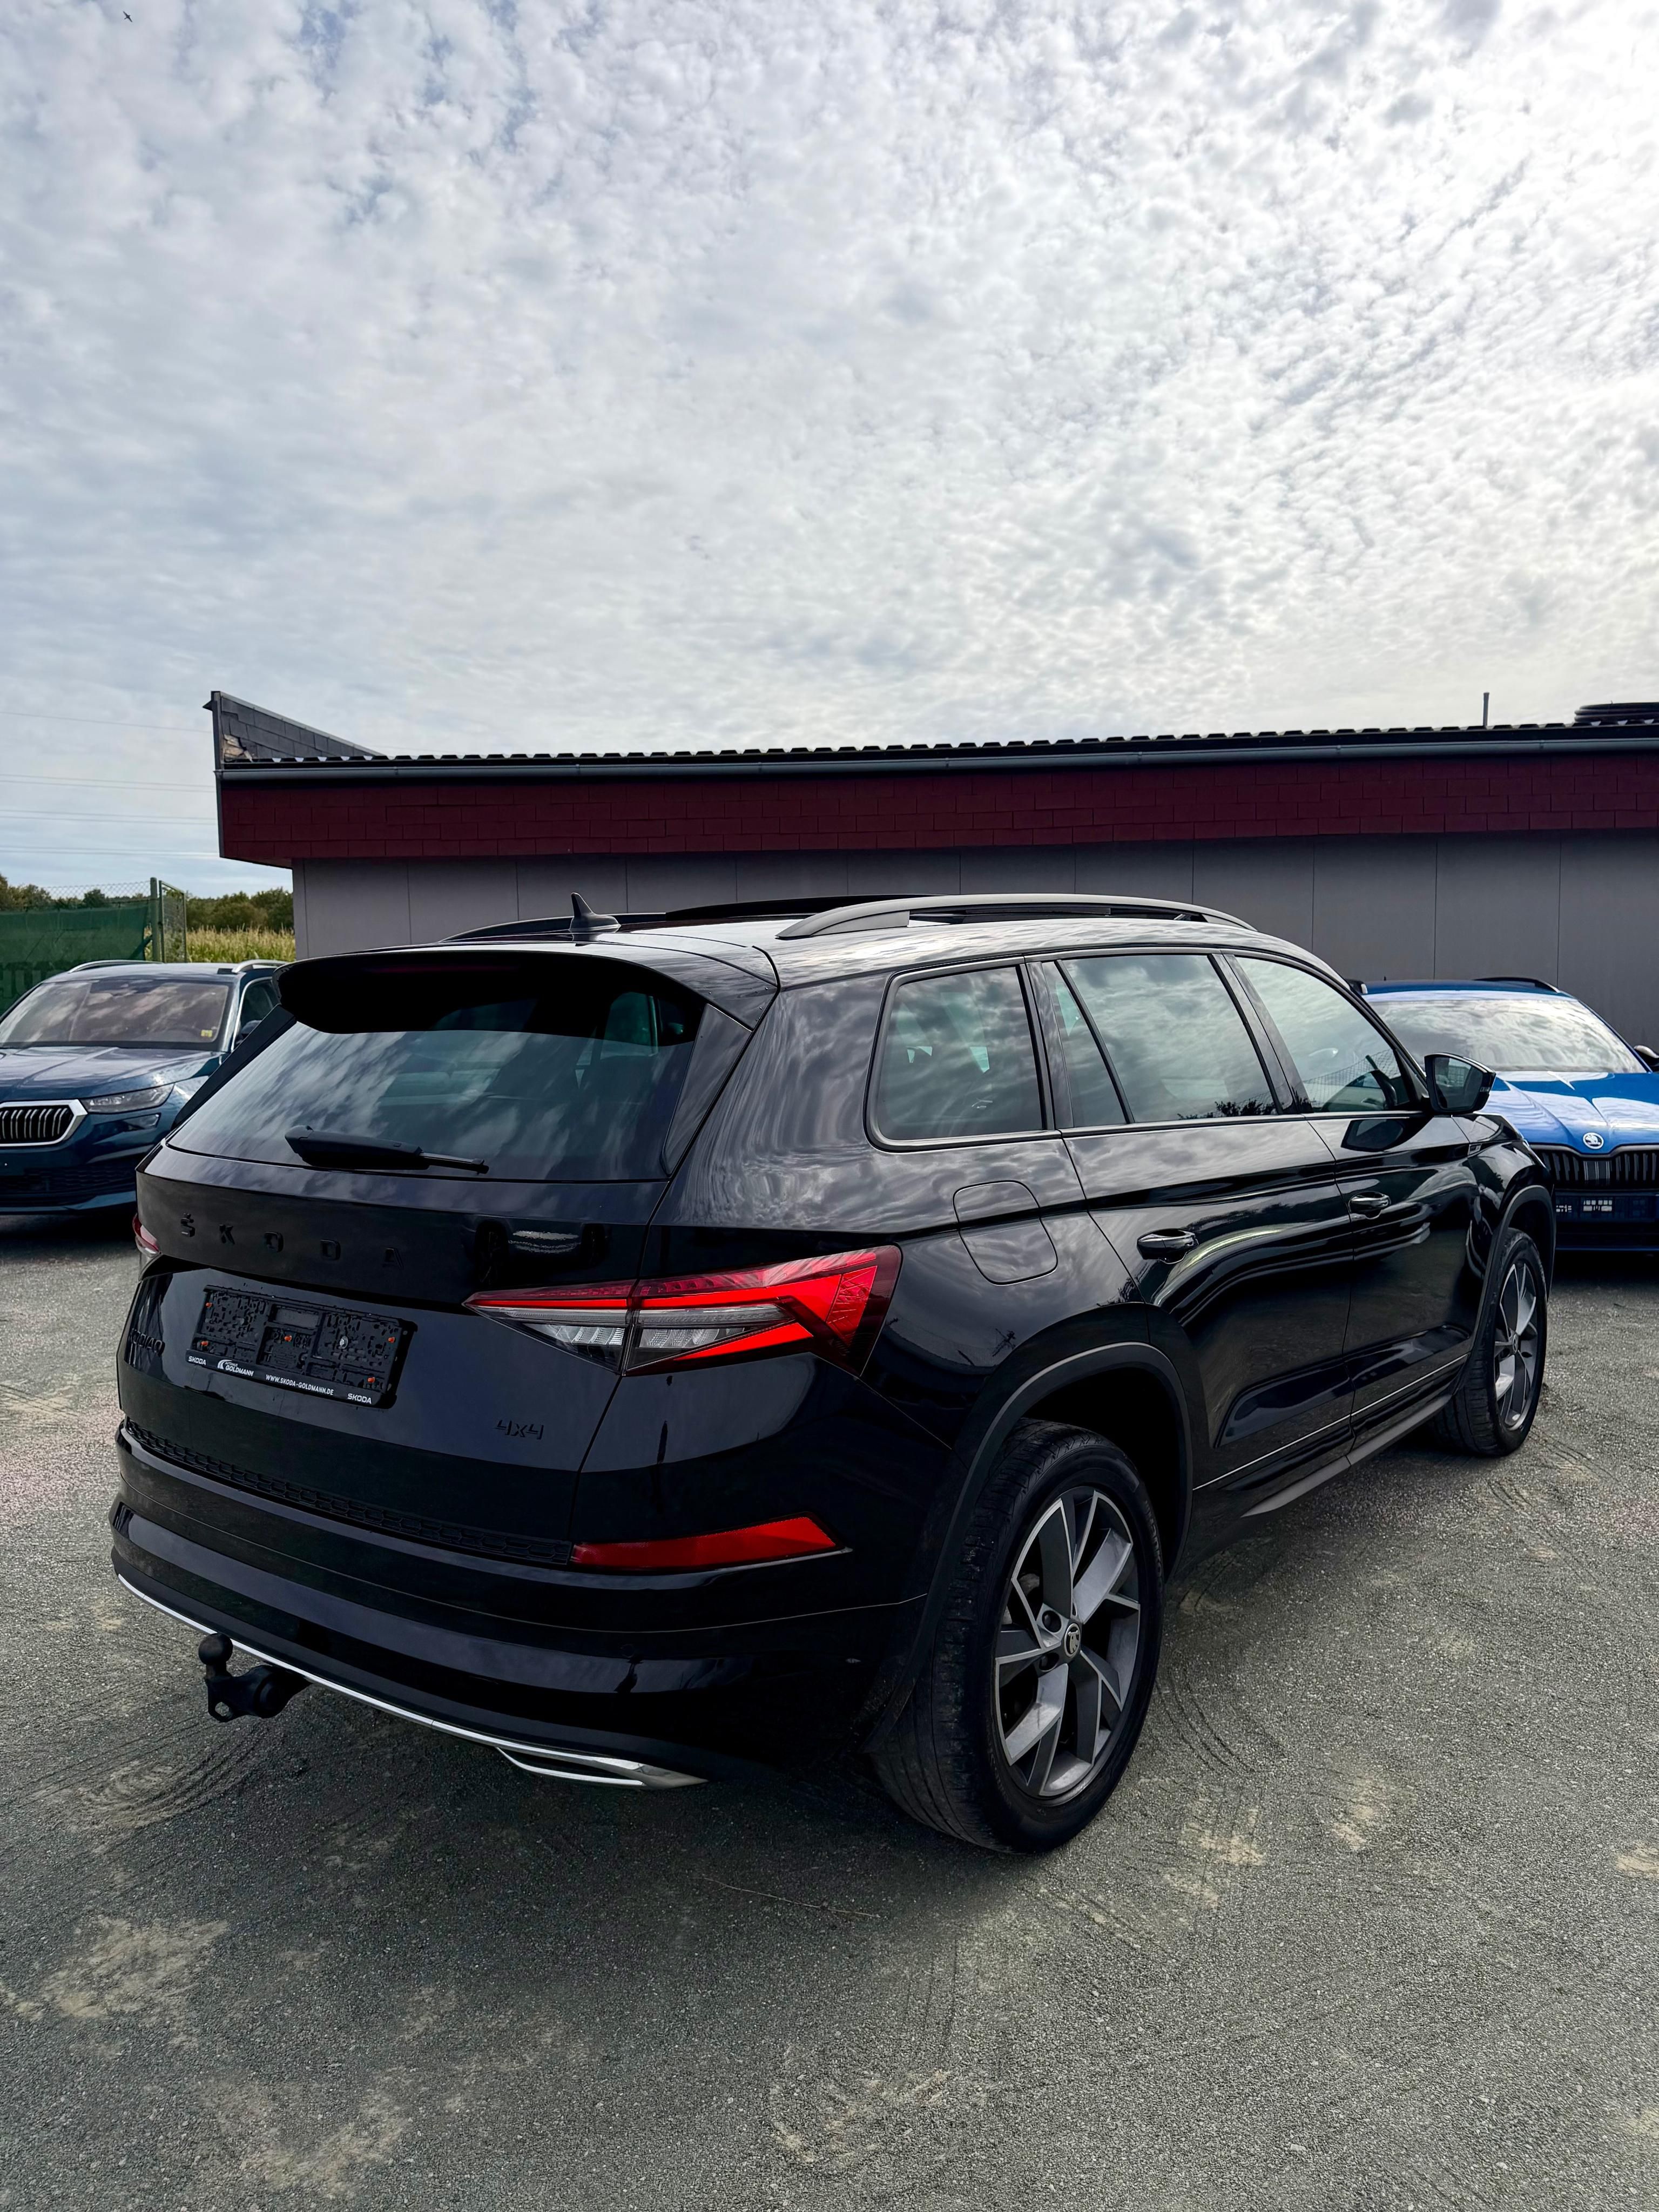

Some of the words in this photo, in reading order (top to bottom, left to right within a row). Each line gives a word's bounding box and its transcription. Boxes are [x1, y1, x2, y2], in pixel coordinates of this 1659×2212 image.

[188, 1356, 206, 1365] SKODA
[225, 1365, 254, 1377] GOLDMANN
[266, 1374, 334, 1395] WWW.SKODA-GOLDMANN.DE
[347, 1393, 372, 1404] SKODA
